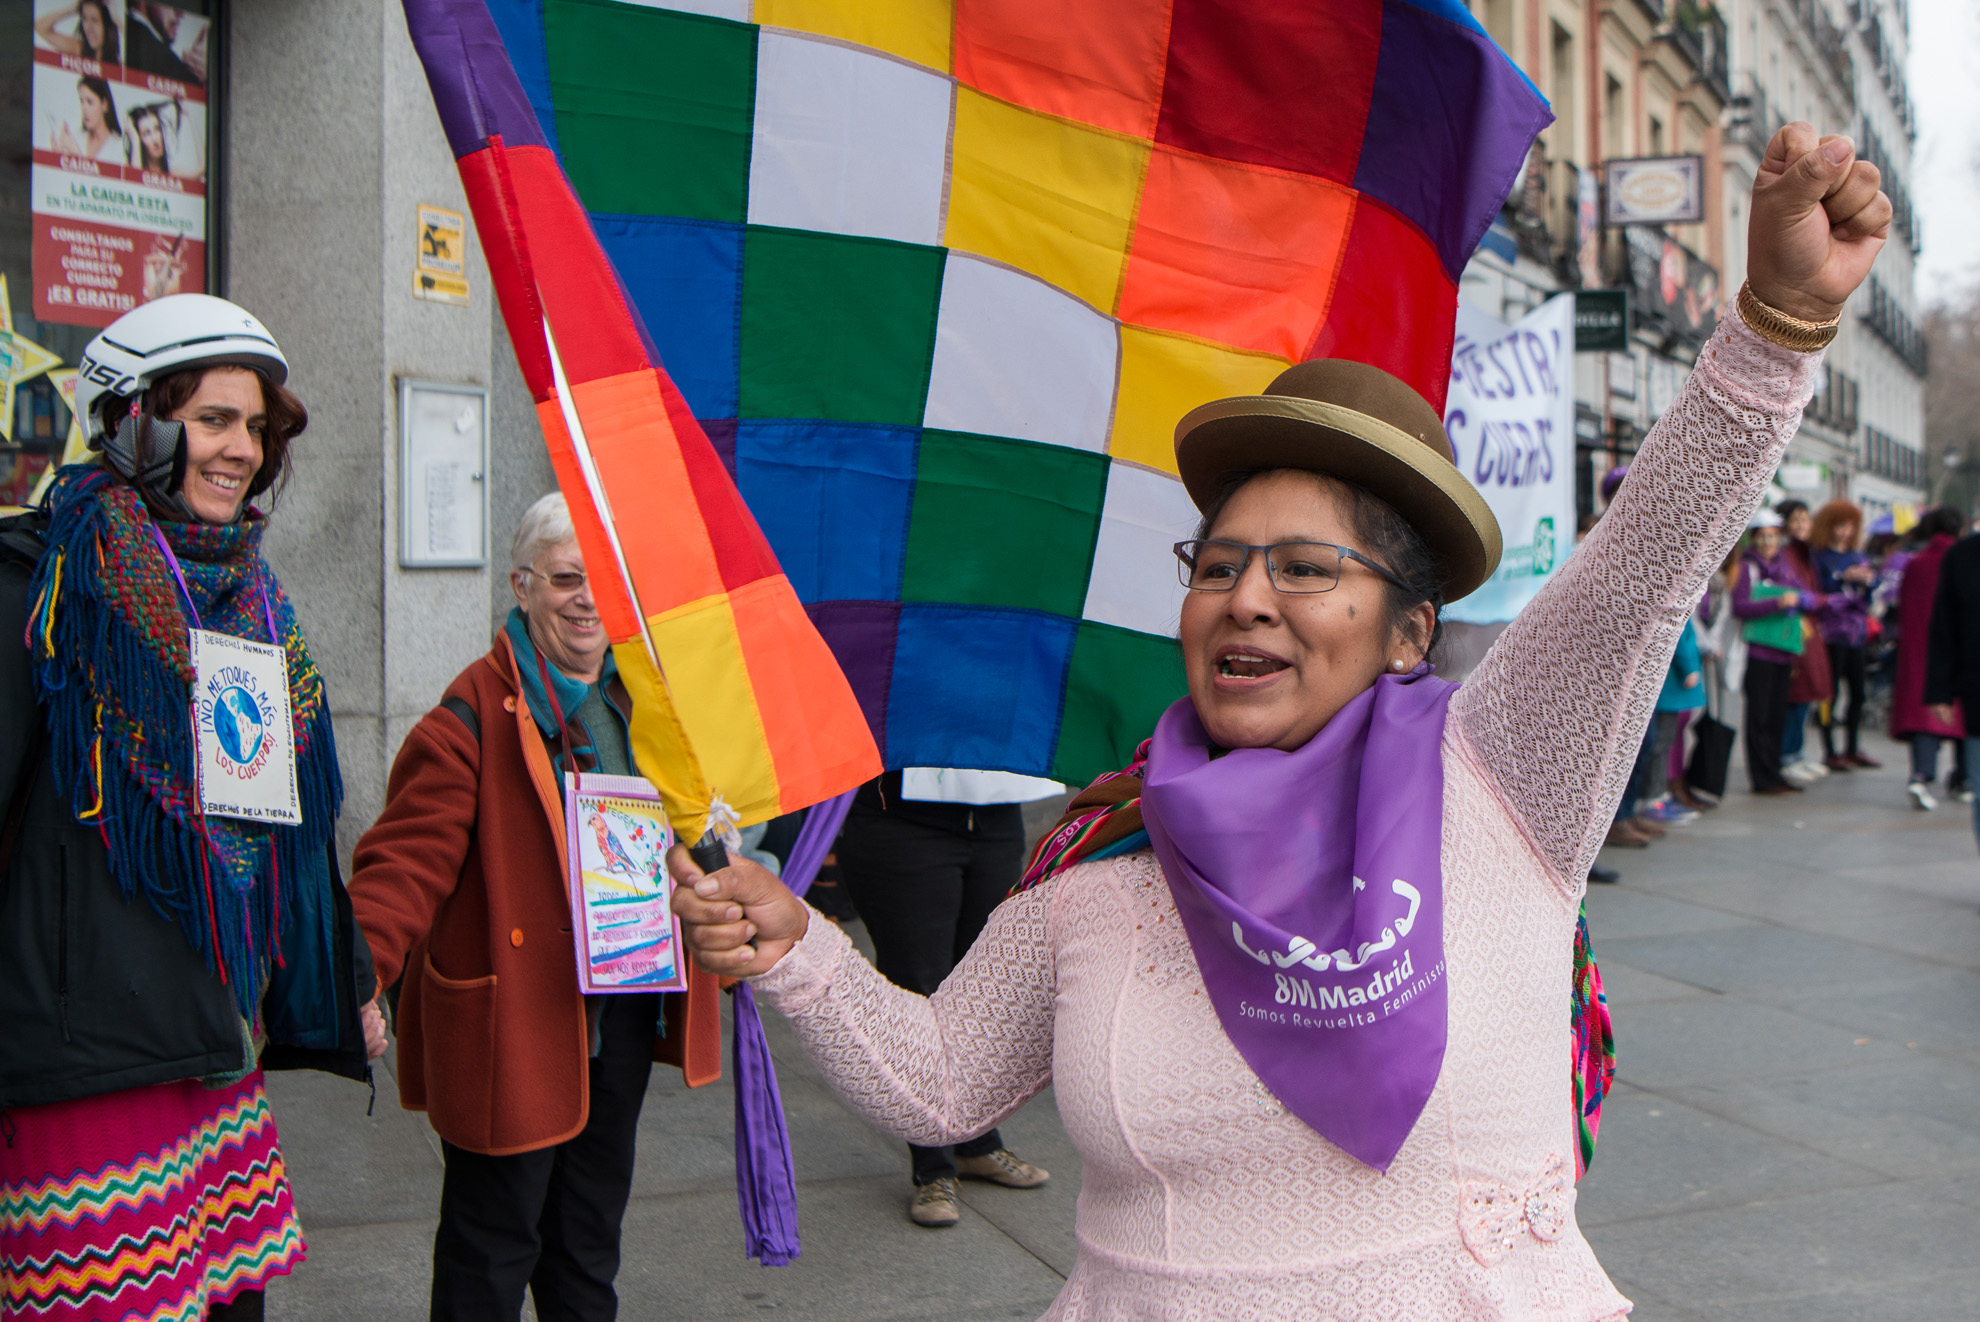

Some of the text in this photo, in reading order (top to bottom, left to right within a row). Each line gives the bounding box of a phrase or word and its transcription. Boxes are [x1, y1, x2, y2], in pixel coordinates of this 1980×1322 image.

[60, 54, 102, 77] PICOR
[146, 74, 186, 97] CASPA
[71, 181, 87, 198] LA
[91, 185, 134, 206] CAUSA
[142, 172, 184, 193] GRASA
[46, 194, 60, 209] EN
[63, 197, 76, 211] TU
[79, 200, 125, 219] APARATO
[70, 243, 115, 263] PARA SU
[61, 255, 124, 278] CORRECTO
[66, 270, 119, 290] CUIDADO
[47, 284, 136, 311] ¡ES GRATIS!
[204, 633, 275, 658] DERECHOS HUMANOS
[207, 674, 224, 699] ME
[218, 666, 258, 693] TOQUES
[256, 690, 278, 727] MÁS
[215, 746, 234, 776] LOS
[287, 763, 297, 808] DERECHOS
[201, 801, 240, 816] DERECHOS
[265, 808, 295, 820] TIERRA
[1239, 959, 1445, 1029] Somos Revuelta Feminista
